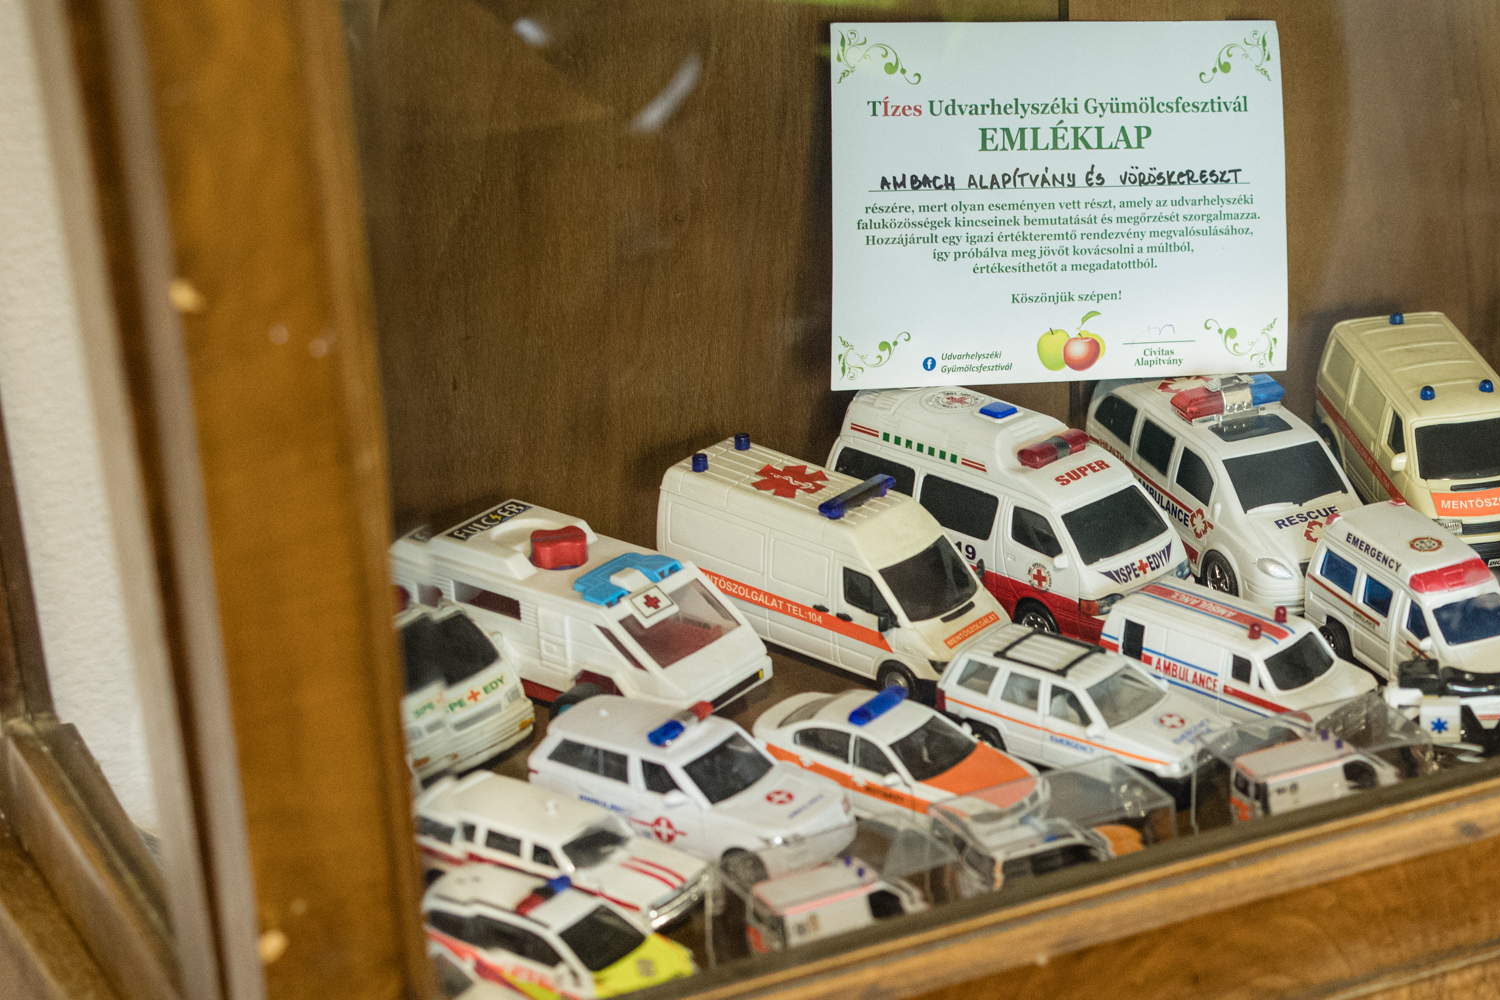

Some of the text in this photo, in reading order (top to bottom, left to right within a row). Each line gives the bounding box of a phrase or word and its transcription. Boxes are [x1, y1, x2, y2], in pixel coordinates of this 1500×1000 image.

[867, 96, 1249, 119] TÍzes Udvarhelyszéki Gyümölcsfesztivál
[978, 119, 1152, 152] EMLÉKLAP
[880, 164, 1242, 191] AMBACH ALAPÍTVÁNY ÉS VÖRÖSKERESZT
[865, 194, 1254, 215] részére, mert olyan eseményen vett részt, amely az udvarhelyszéki
[856, 210, 1261, 231] faluközösségek kincseinek bemutatását és megőrzését szorgalmazza.
[865, 225, 1254, 247] Hozzájárult egy igazi értékteremtő rendezvény megvalósulásához,
[933, 242, 1194, 262] így próbálva meg jövőt kovácsolni a múltból,
[972, 258, 1158, 274] értékesíthetőt a megadatottból.
[1011, 290, 1122, 305] Köszönjük szépen!
[941, 351, 1002, 362] Udvarhelyszéki
[1134, 355, 1184, 368] Alapítvány
[1143, 348, 1175, 357] Civitas
[941, 362, 1013, 374] Gyümölcsfesztivál
[1098, 439, 1125, 462] HEALTH
[1054, 459, 1110, 487] SUPER
[1274, 505, 1340, 530] RESCUE
[1346, 533, 1402, 572] EMERGENCY
[1171, 592, 1238, 617] AMBULANCE
[1155, 659, 1219, 693] AMBULANCE
